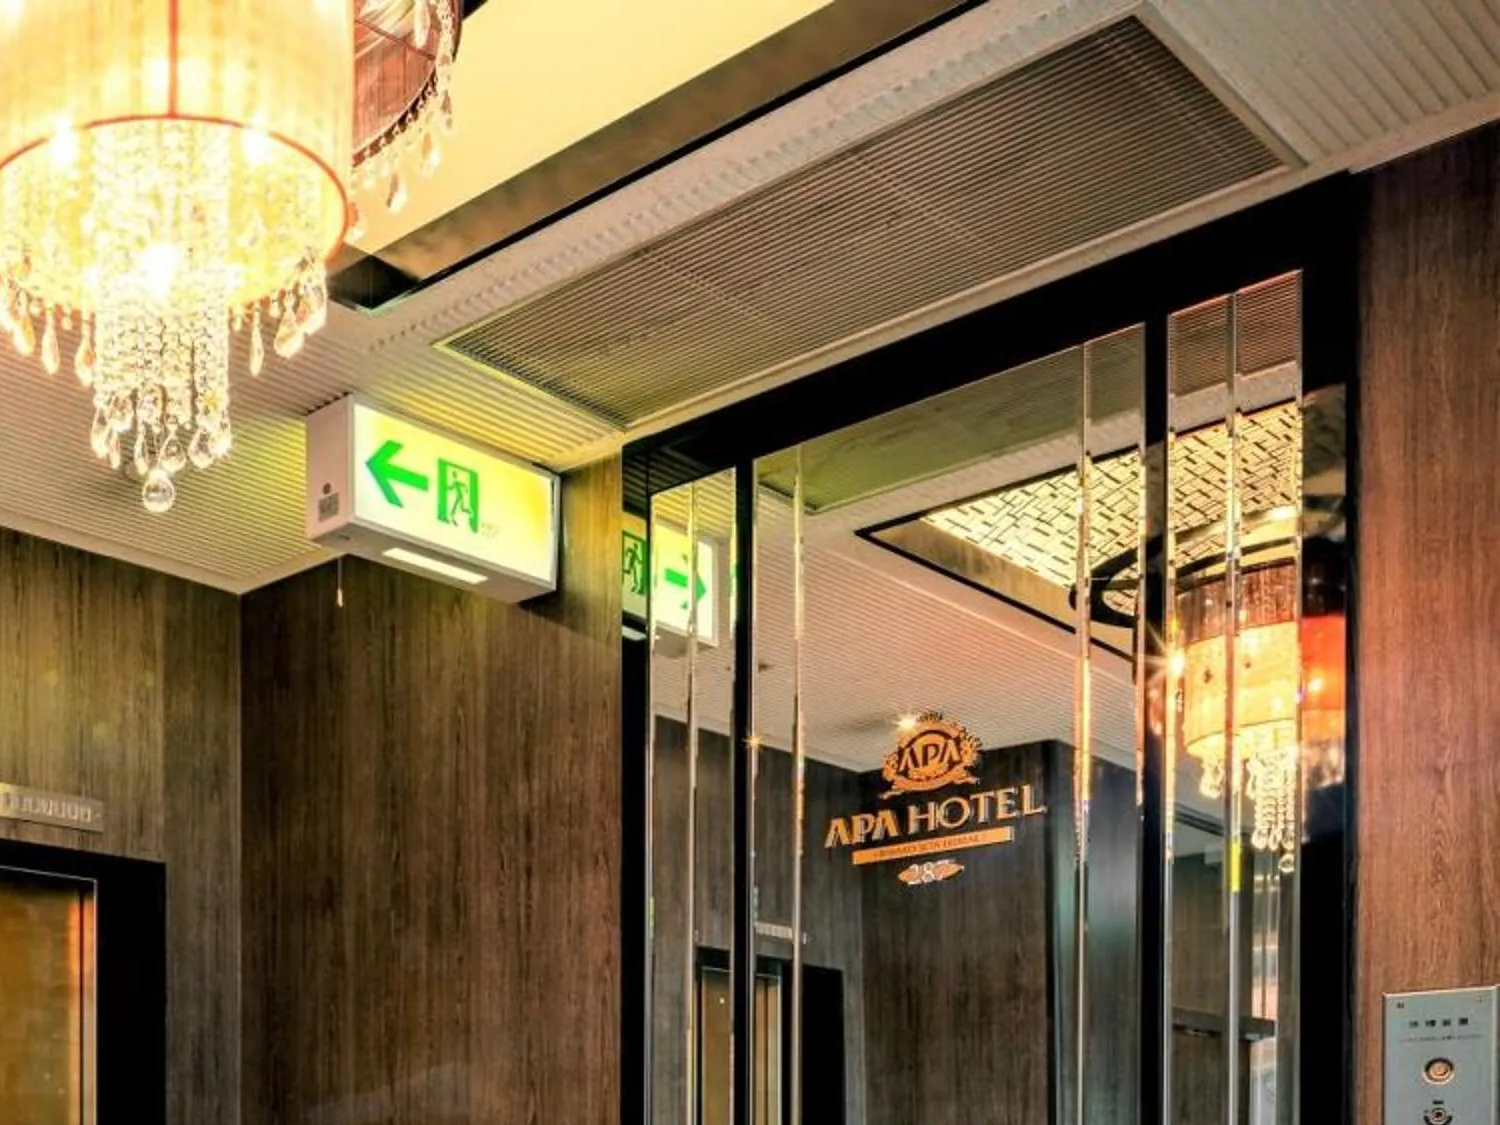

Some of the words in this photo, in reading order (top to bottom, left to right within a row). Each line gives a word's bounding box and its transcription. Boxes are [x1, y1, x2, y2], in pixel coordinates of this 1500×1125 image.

[899, 739, 962, 773] APA
[824, 809, 899, 849] APA
[907, 784, 1048, 835] HOTEL
